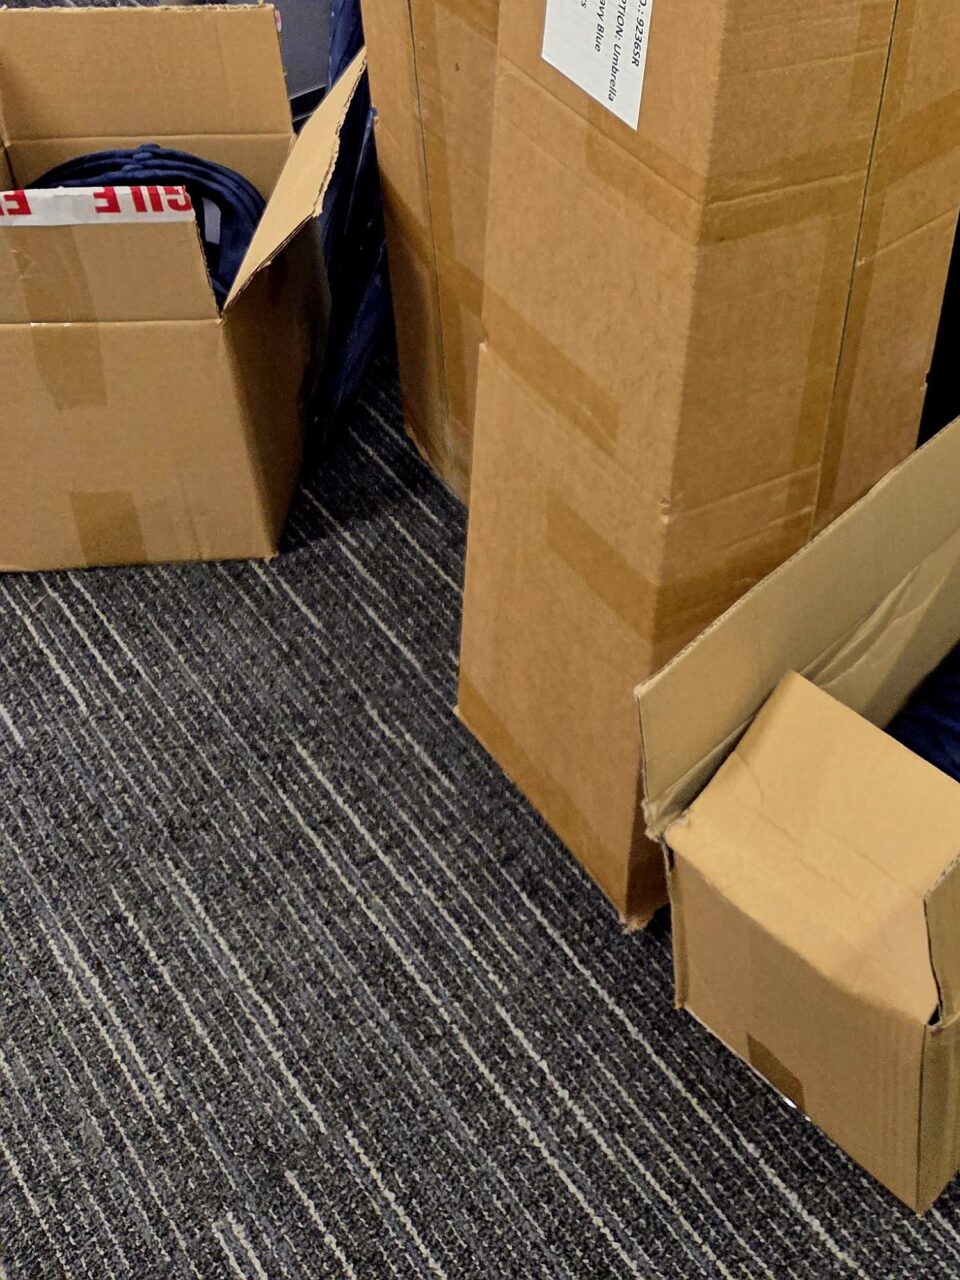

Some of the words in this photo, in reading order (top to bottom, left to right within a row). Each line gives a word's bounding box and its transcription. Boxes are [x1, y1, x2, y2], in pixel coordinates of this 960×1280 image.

[594, 24, 605, 53] Blue
[631, 18, 646, 67] 9236SR
[607, 42, 622, 102] Umbrella
